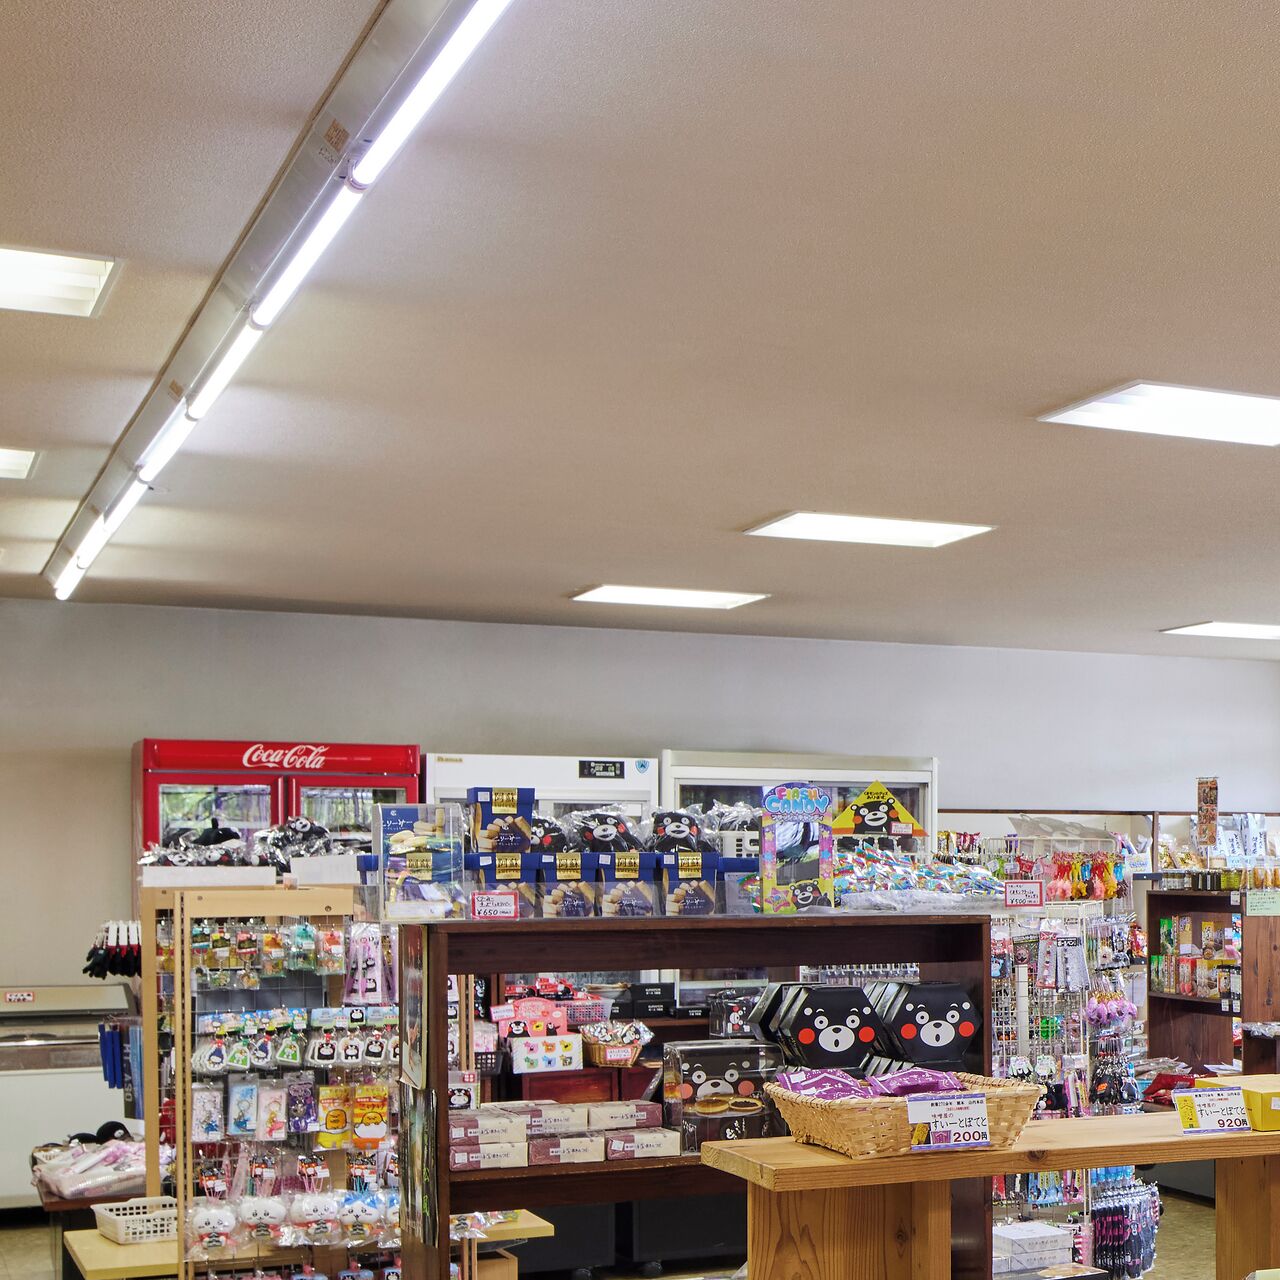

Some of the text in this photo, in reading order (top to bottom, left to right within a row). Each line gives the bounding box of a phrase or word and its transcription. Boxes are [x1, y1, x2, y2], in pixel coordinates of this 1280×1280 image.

[243, 743, 325, 769] Coca-Cola
[776, 787, 817, 801] FLASH
[764, 796, 830, 813] CANDY
[1198, 1106, 1246, 1116] すいーとぽてと
[932, 1116, 987, 1130] すいーとぽてと
[1217, 1118, 1248, 1128] 920円
[953, 1130, 988, 1142] 200円
